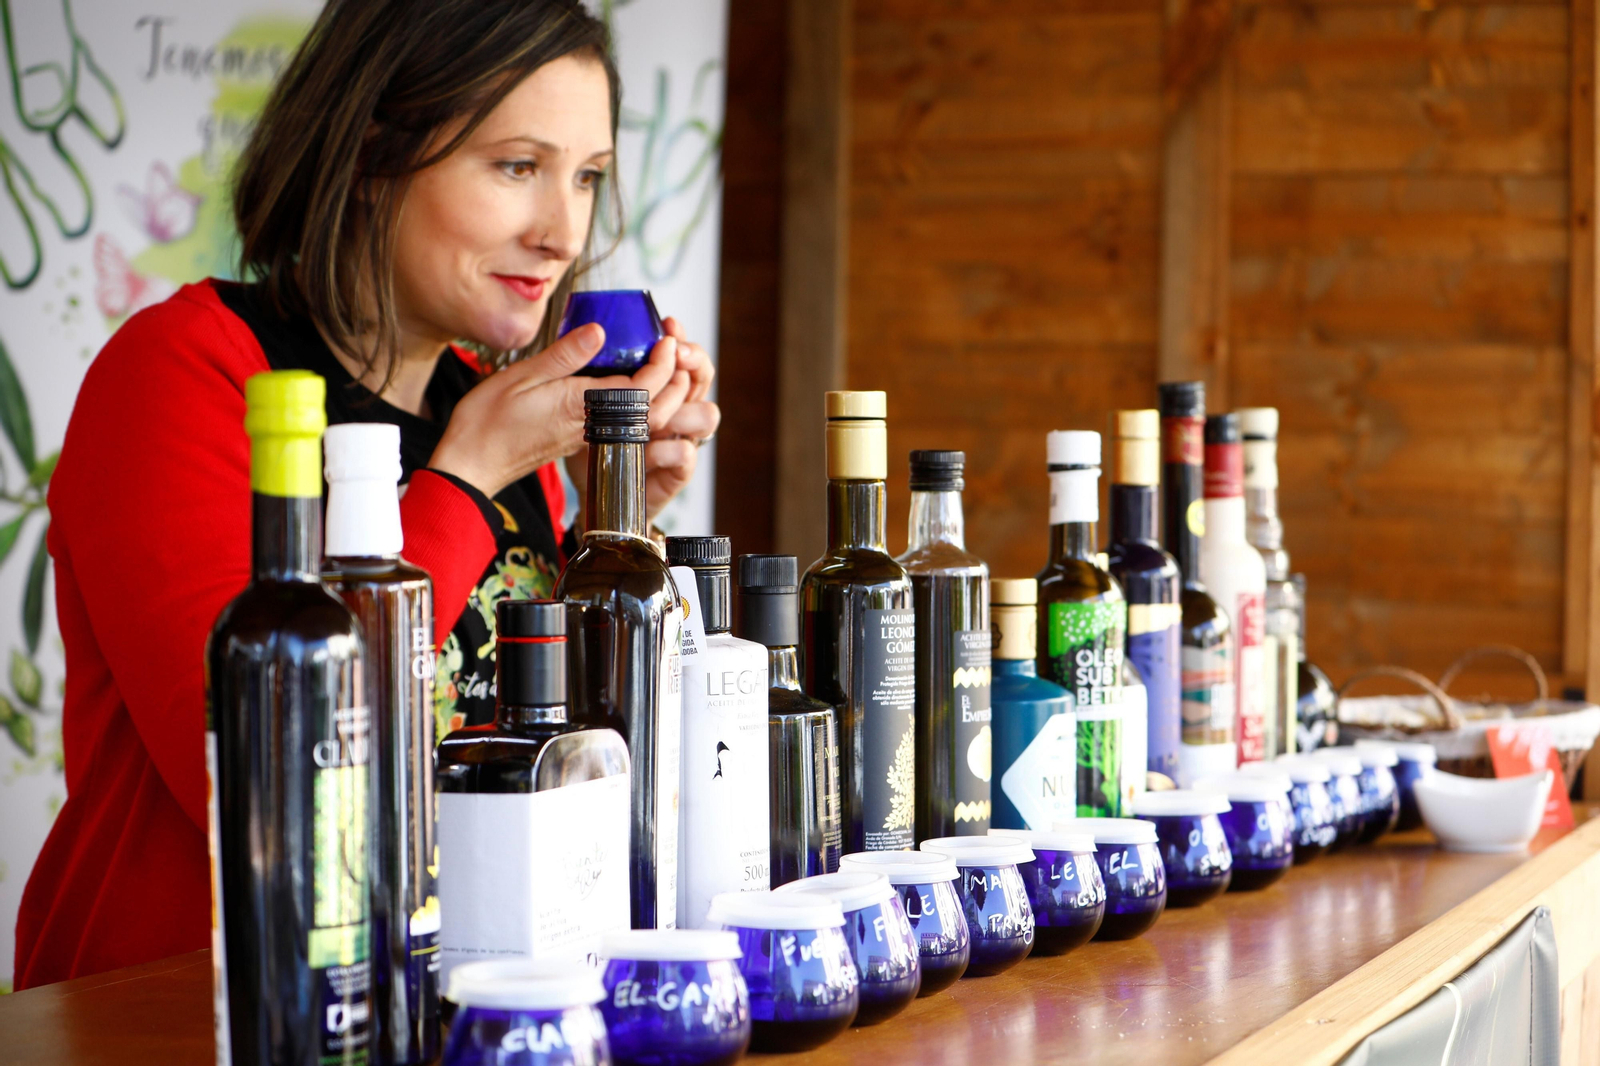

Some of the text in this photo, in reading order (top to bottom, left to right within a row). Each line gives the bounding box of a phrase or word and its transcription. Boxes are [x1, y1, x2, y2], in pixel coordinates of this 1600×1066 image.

[1076, 667, 1113, 686] SUB
[744, 863, 763, 881] 500
[1109, 851, 1138, 874] EL
